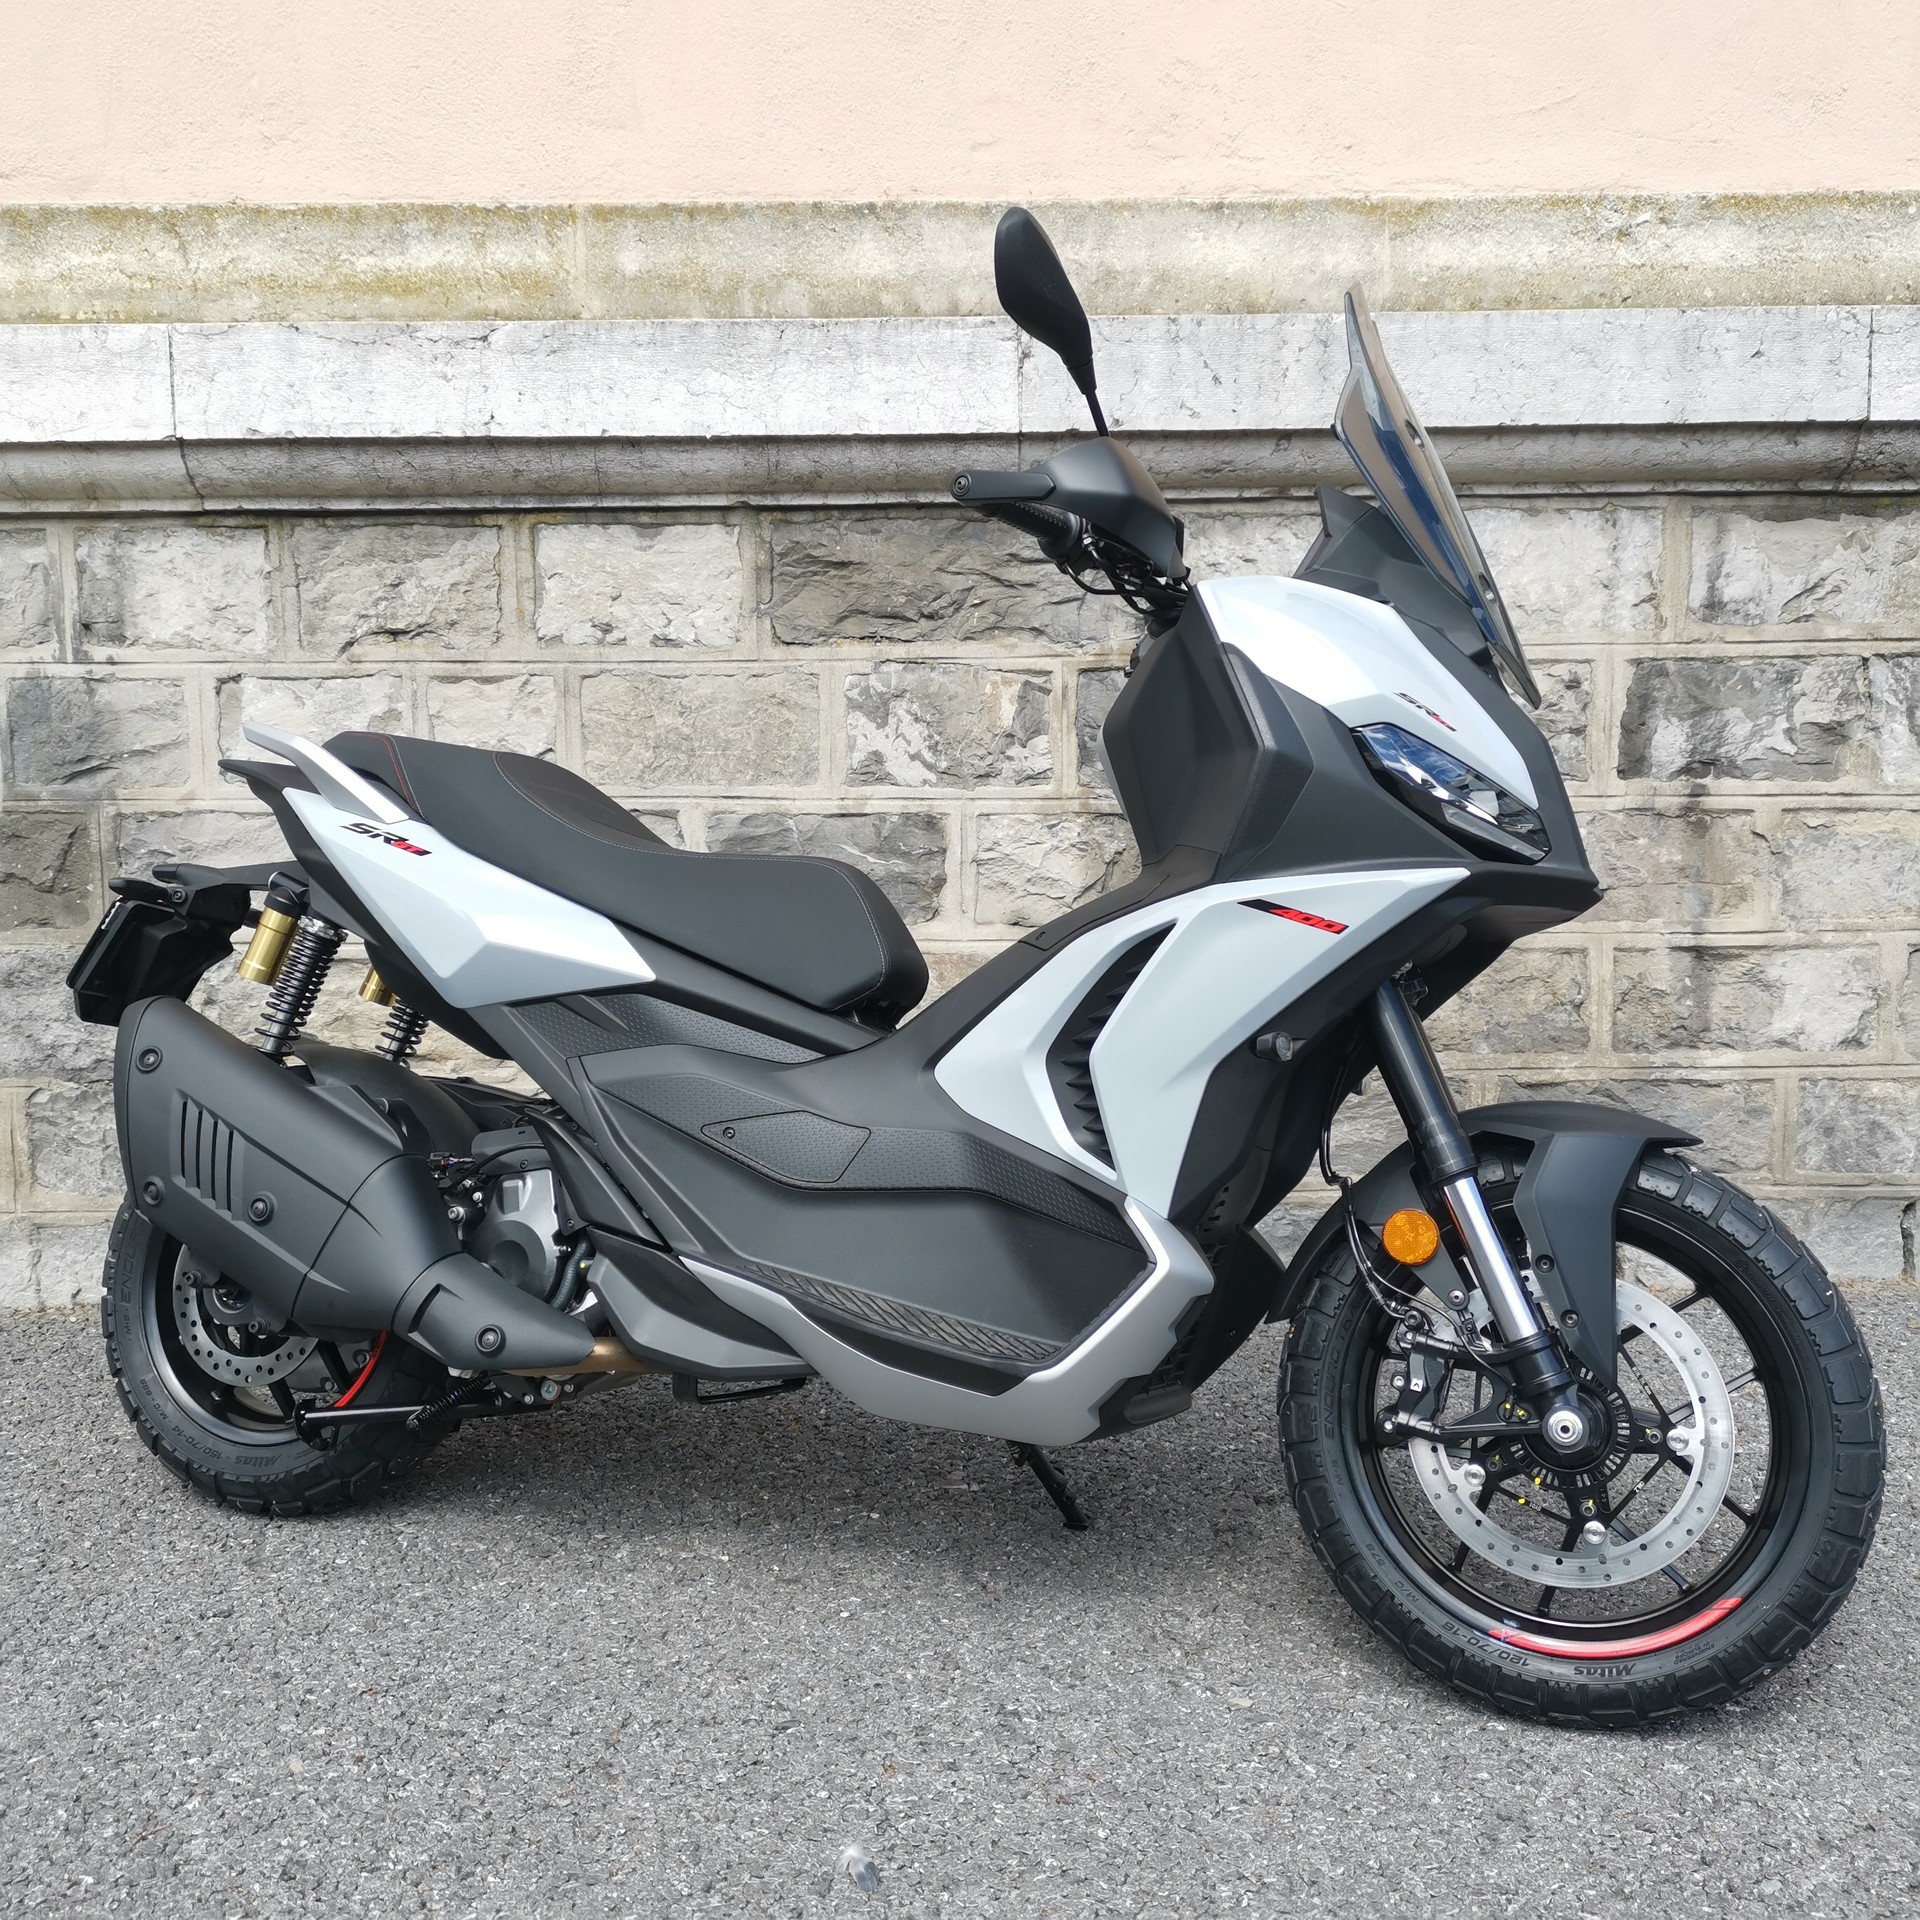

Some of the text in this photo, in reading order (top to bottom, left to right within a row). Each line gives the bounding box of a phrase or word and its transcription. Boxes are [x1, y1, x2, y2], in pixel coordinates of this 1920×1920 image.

[1266, 907, 1348, 934] 400
[153, 1403, 169, 1420] M/C
[172, 1424, 223, 1461] 150/70-14
[234, 1454, 283, 1467] Mitas
[1394, 1579, 1419, 1604] M/C
[1441, 1620, 1530, 1668] 120/70-16
[1573, 1662, 1637, 1678] Mitas
